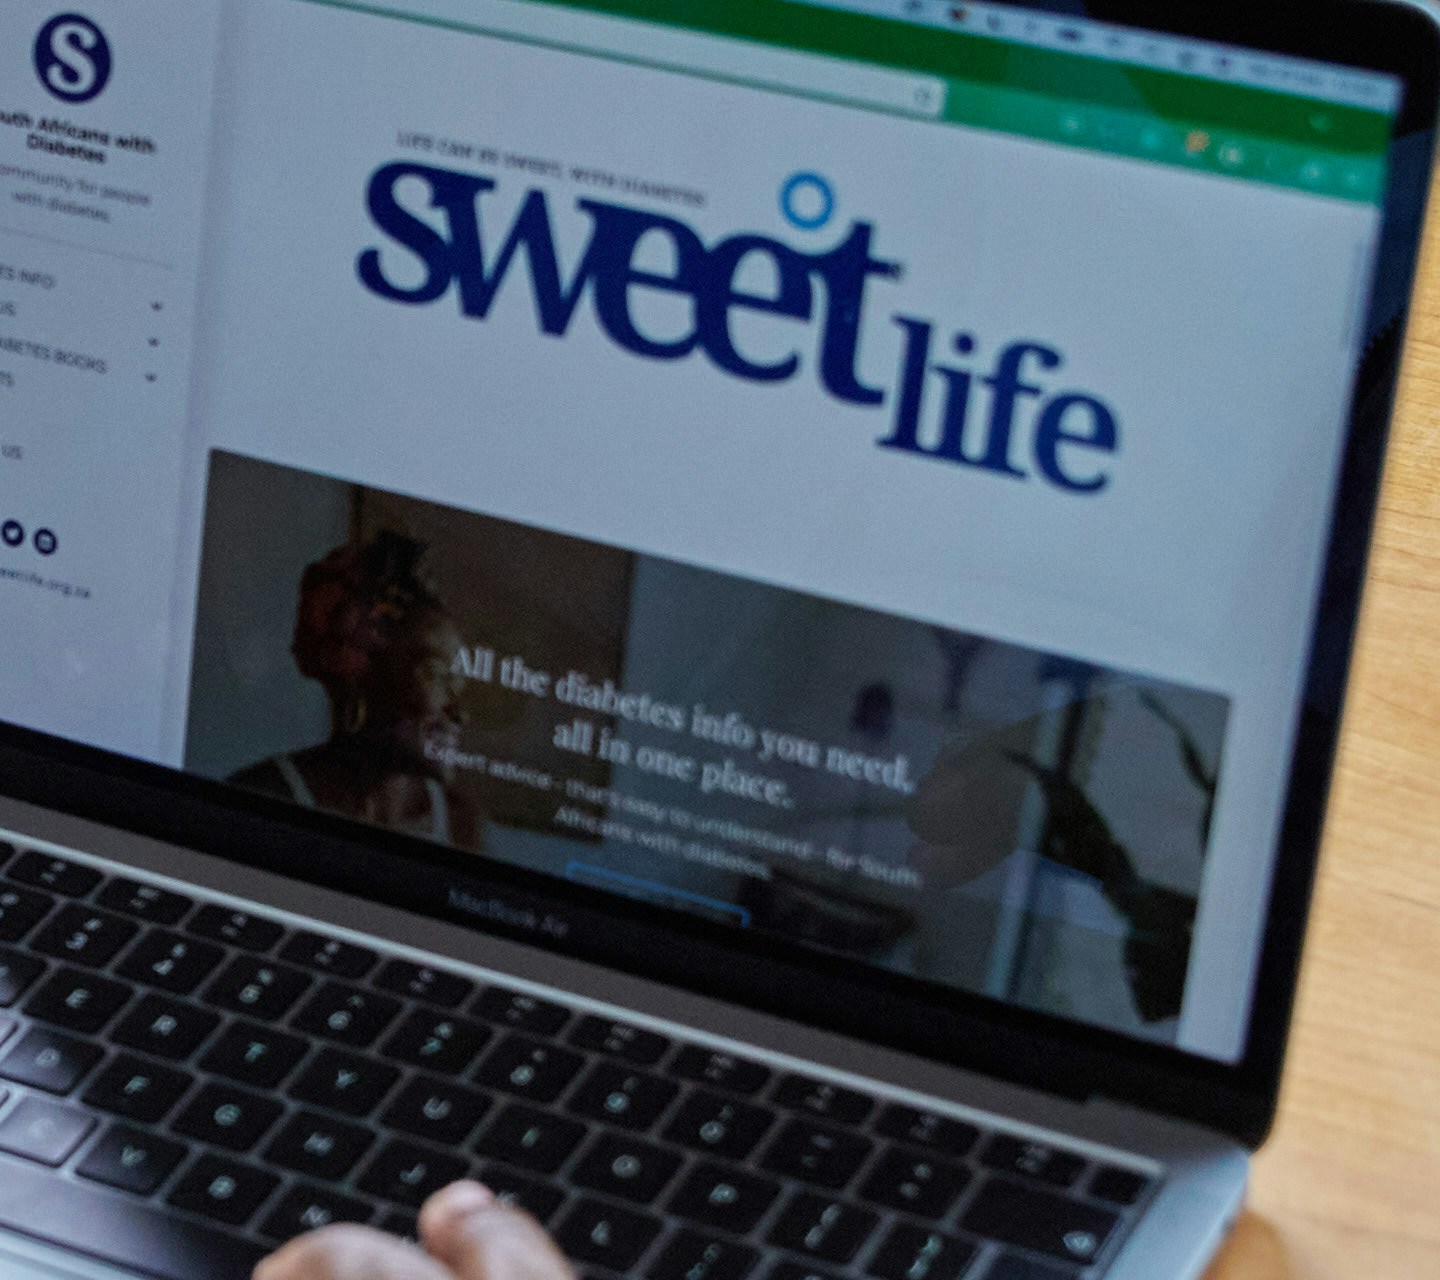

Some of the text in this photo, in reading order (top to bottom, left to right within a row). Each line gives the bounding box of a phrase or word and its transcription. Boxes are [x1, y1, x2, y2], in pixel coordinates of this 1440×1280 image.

[47, 24, 96, 94] S
[26, 133, 107, 164] Diabetes
[37, 117, 110, 145] Africans
[115, 135, 156, 154] with
[397, 129, 434, 151] LIFE
[437, 140, 472, 160] CAN
[477, 148, 499, 166] BE
[570, 166, 617, 189] WITH
[621, 178, 708, 208] DIABETES
[12, 191, 43, 207] with
[76, 177, 98, 195] for
[100, 185, 152, 208] people
[19, 269, 57, 291] INFO
[355, 161, 1120, 495] sweet life
[53, 349, 109, 375] BOOKS
[1, 445, 24, 461] US
[449, 646, 494, 682] All
[500, 658, 552, 696] the
[554, 671, 685, 731] diabetes
[691, 704, 756, 750] info
[758, 728, 820, 768] you
[552, 721, 794, 809] all in one place.
[490, 757, 551, 790] advice
[694, 808, 813, 859] understand
[859, 853, 921, 888] South
[639, 831, 680, 855] with
